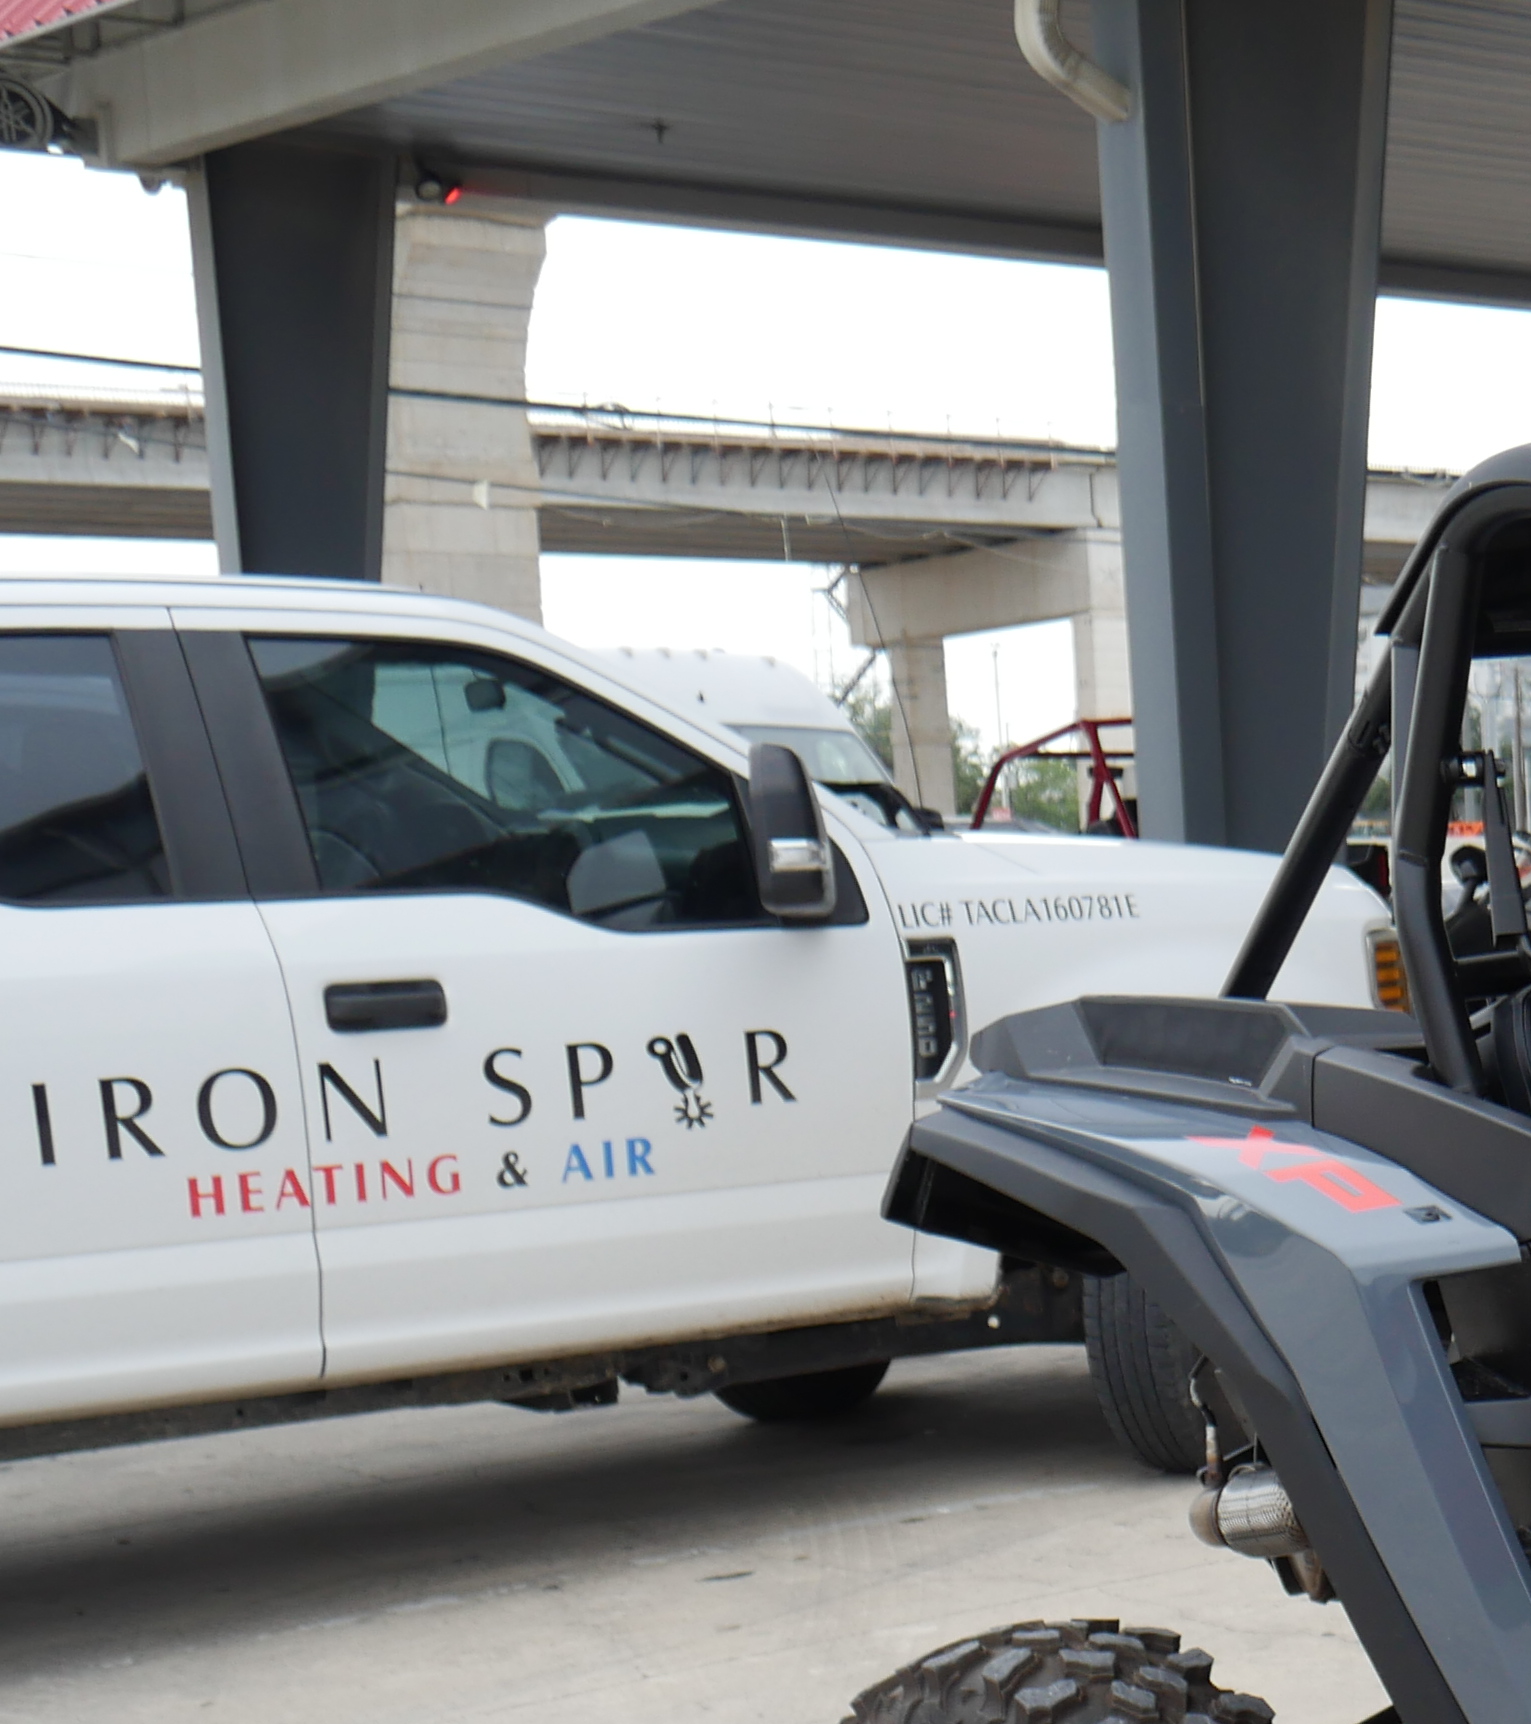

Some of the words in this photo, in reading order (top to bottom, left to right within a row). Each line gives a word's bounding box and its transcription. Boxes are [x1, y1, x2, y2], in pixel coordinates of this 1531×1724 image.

[897, 900, 952, 929] LIC#
[963, 894, 1140, 926] TACLA160781E
[31, 1058, 389, 1167] IRON
[186, 1153, 463, 1218] HEATING
[495, 1150, 529, 1189] &
[561, 1136, 657, 1184] AIR
[1185, 1124, 1404, 1214] XP
